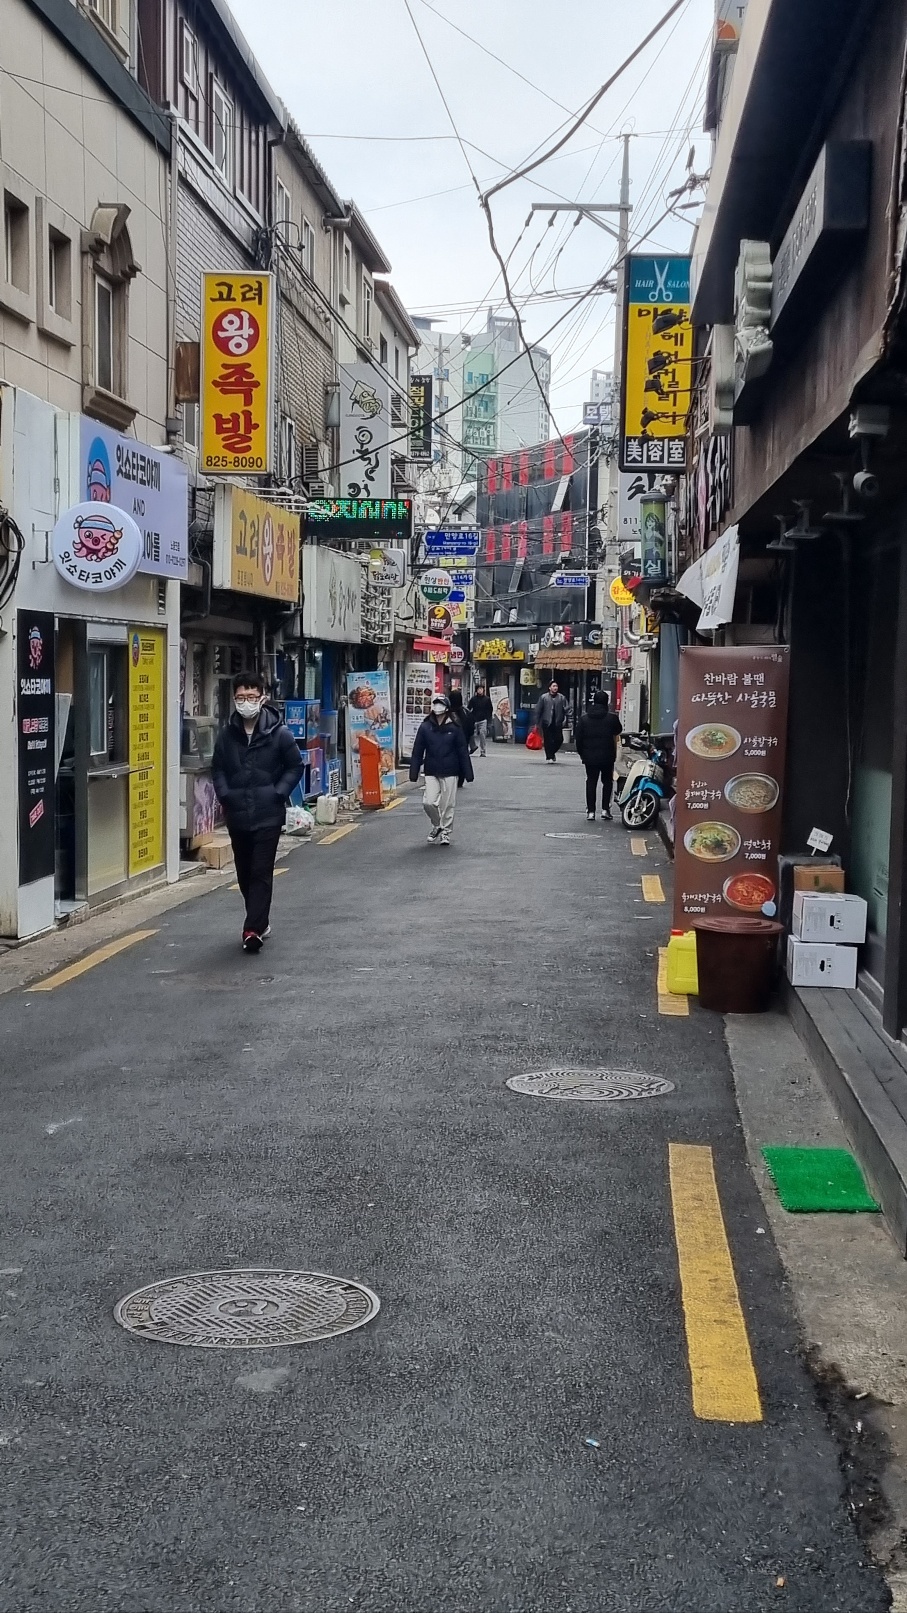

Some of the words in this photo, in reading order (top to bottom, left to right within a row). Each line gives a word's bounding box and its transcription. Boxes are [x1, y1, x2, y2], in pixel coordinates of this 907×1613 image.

[635, 279, 654, 288] HAIR
[666, 279, 690, 288] SALON
[210, 281, 263, 305] 고려
[626, 440, 685, 461] 美容室
[116, 444, 161, 492] 잇쇼타코야끼
[205, 455, 263, 469] 825-8090
[132, 498, 146, 516] AND
[58, 550, 127, 584] 잇쇼타코야끼
[434, 606, 445, 618] 9
[703, 672, 738, 686] 찬바람
[741, 672, 764, 686] 불땐
[691, 691, 732, 707] 따뜻한
[736, 690, 777, 708] 사골국물
[687, 802, 709, 810] 7,000원
